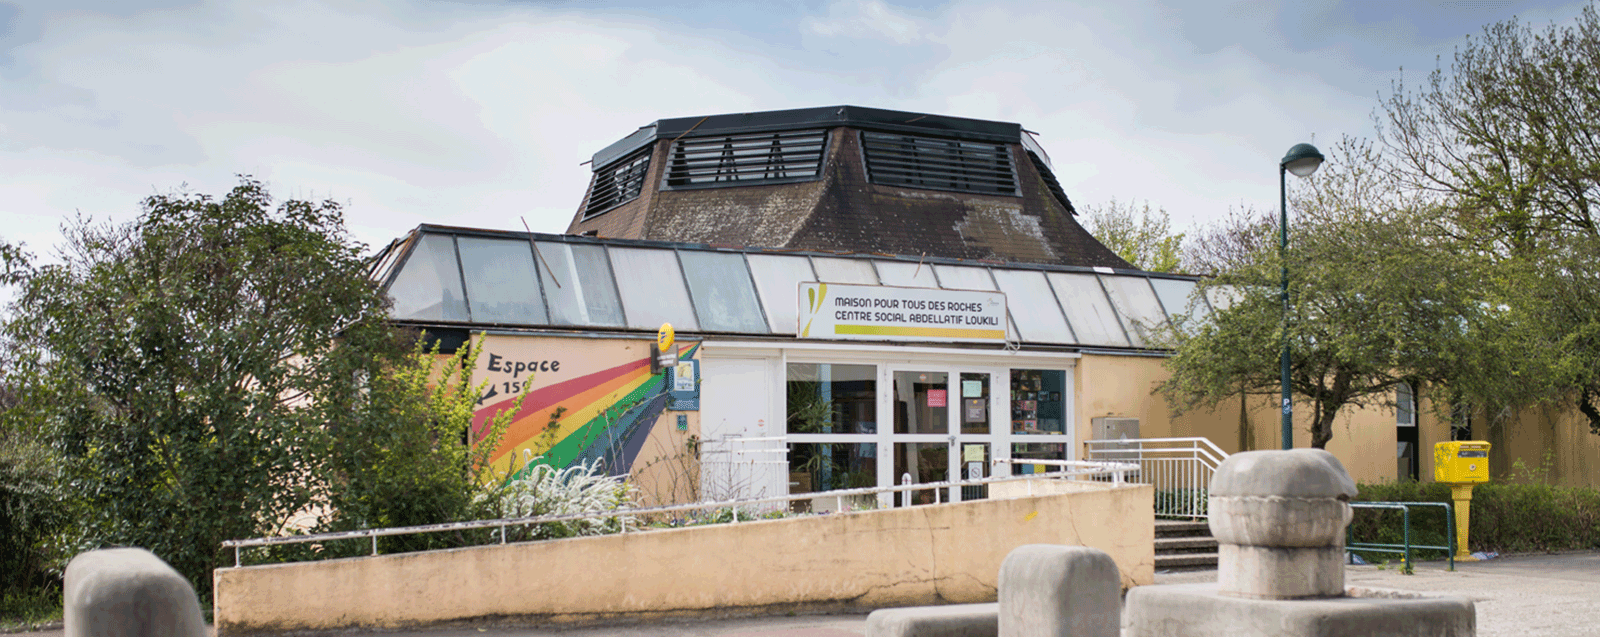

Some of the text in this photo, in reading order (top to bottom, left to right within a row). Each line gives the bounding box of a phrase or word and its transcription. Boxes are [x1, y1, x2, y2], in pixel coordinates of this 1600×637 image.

[835, 297, 872, 308] MAISON
[874, 299, 899, 309] POUR
[902, 300, 926, 310] TOUS
[928, 301, 946, 311] DES
[948, 302, 982, 312] ROCHES
[835, 311, 998, 326] CENTRE SOCIAL ABDELLATIF LOUKILI
[487, 352, 560, 378] Espace
